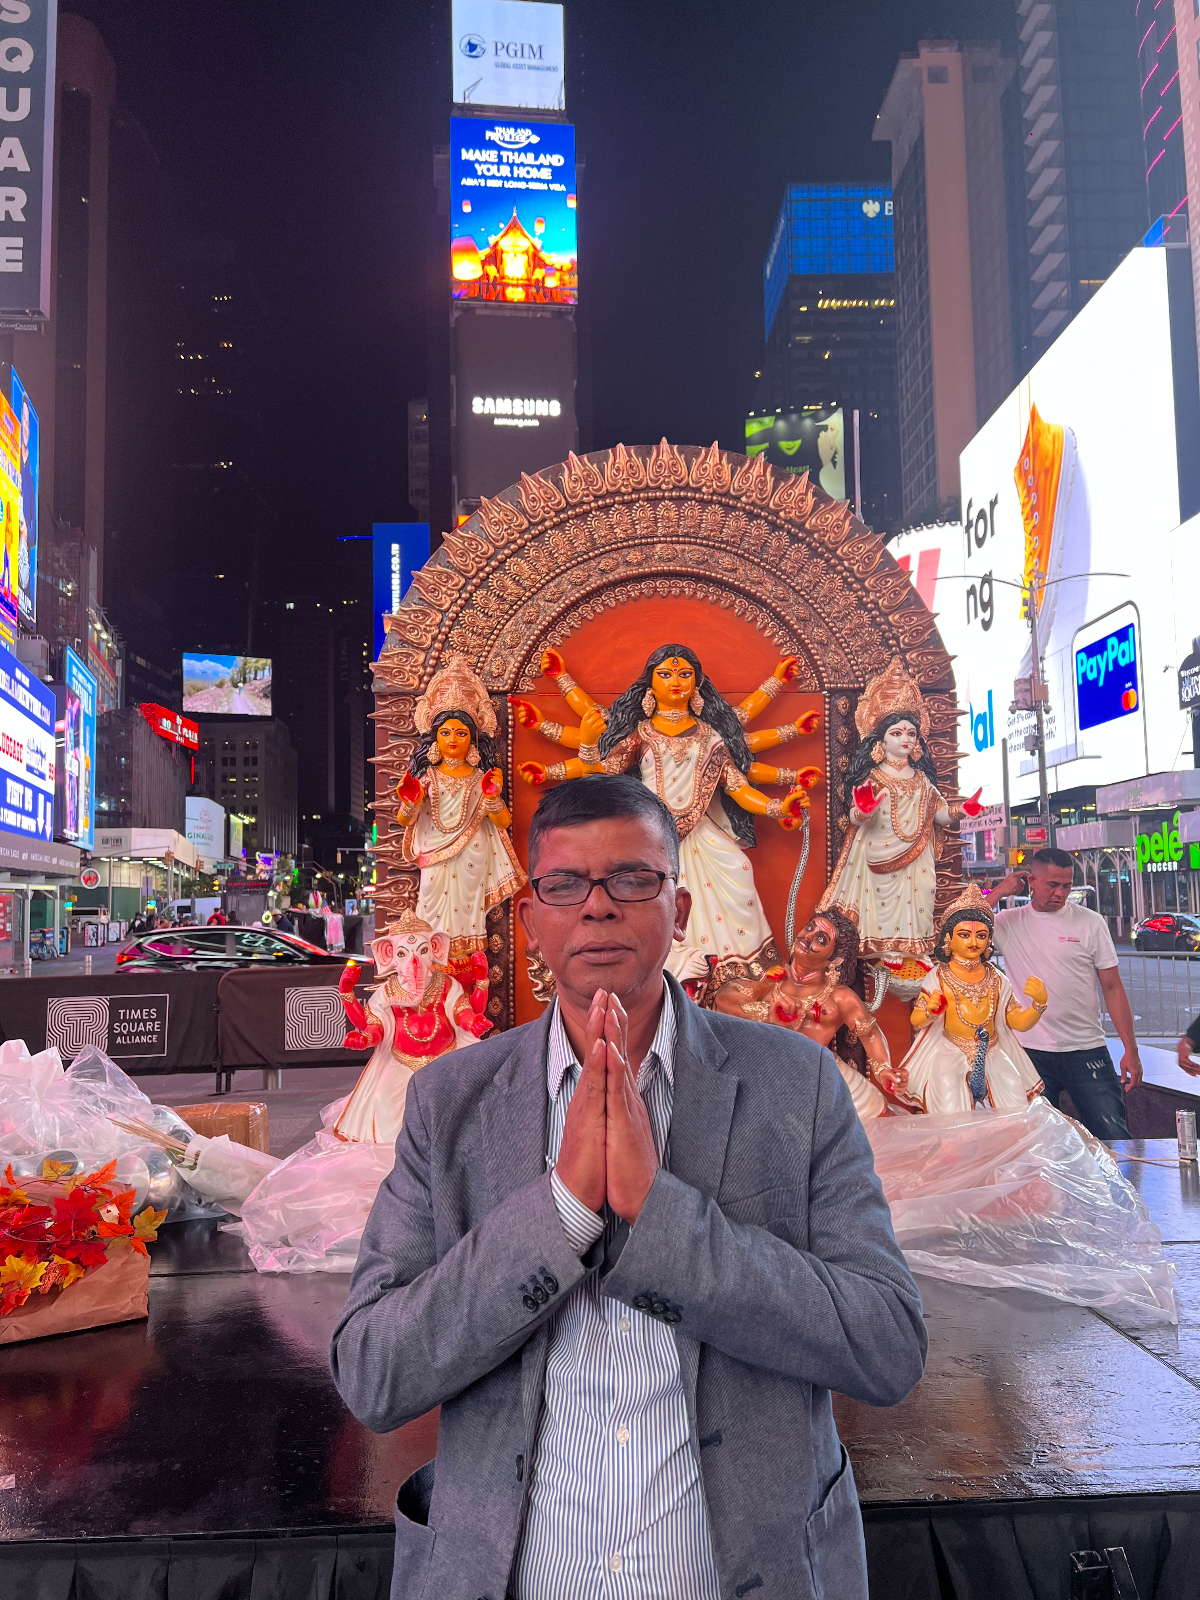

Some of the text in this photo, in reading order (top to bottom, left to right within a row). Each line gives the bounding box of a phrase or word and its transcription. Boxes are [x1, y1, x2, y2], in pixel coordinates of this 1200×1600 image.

[492, 40, 545, 60] PGIM
[461, 148, 565, 167] MAKE THAILAND
[474, 163, 552, 180] YOUR HOME
[471, 396, 561, 416] SAMSUNG
[965, 492, 998, 559] for
[966, 569, 994, 632] ng
[1076, 627, 1135, 687] PayPal
[969, 688, 995, 753] al
[1136, 810, 1183, 873] pelé
[1147, 861, 1178, 872] SOCCER
[118, 1008, 157, 1020] TIMES
[113, 1021, 161, 1034] SQUARE
[115, 1035, 158, 1044] ALLIANCE
